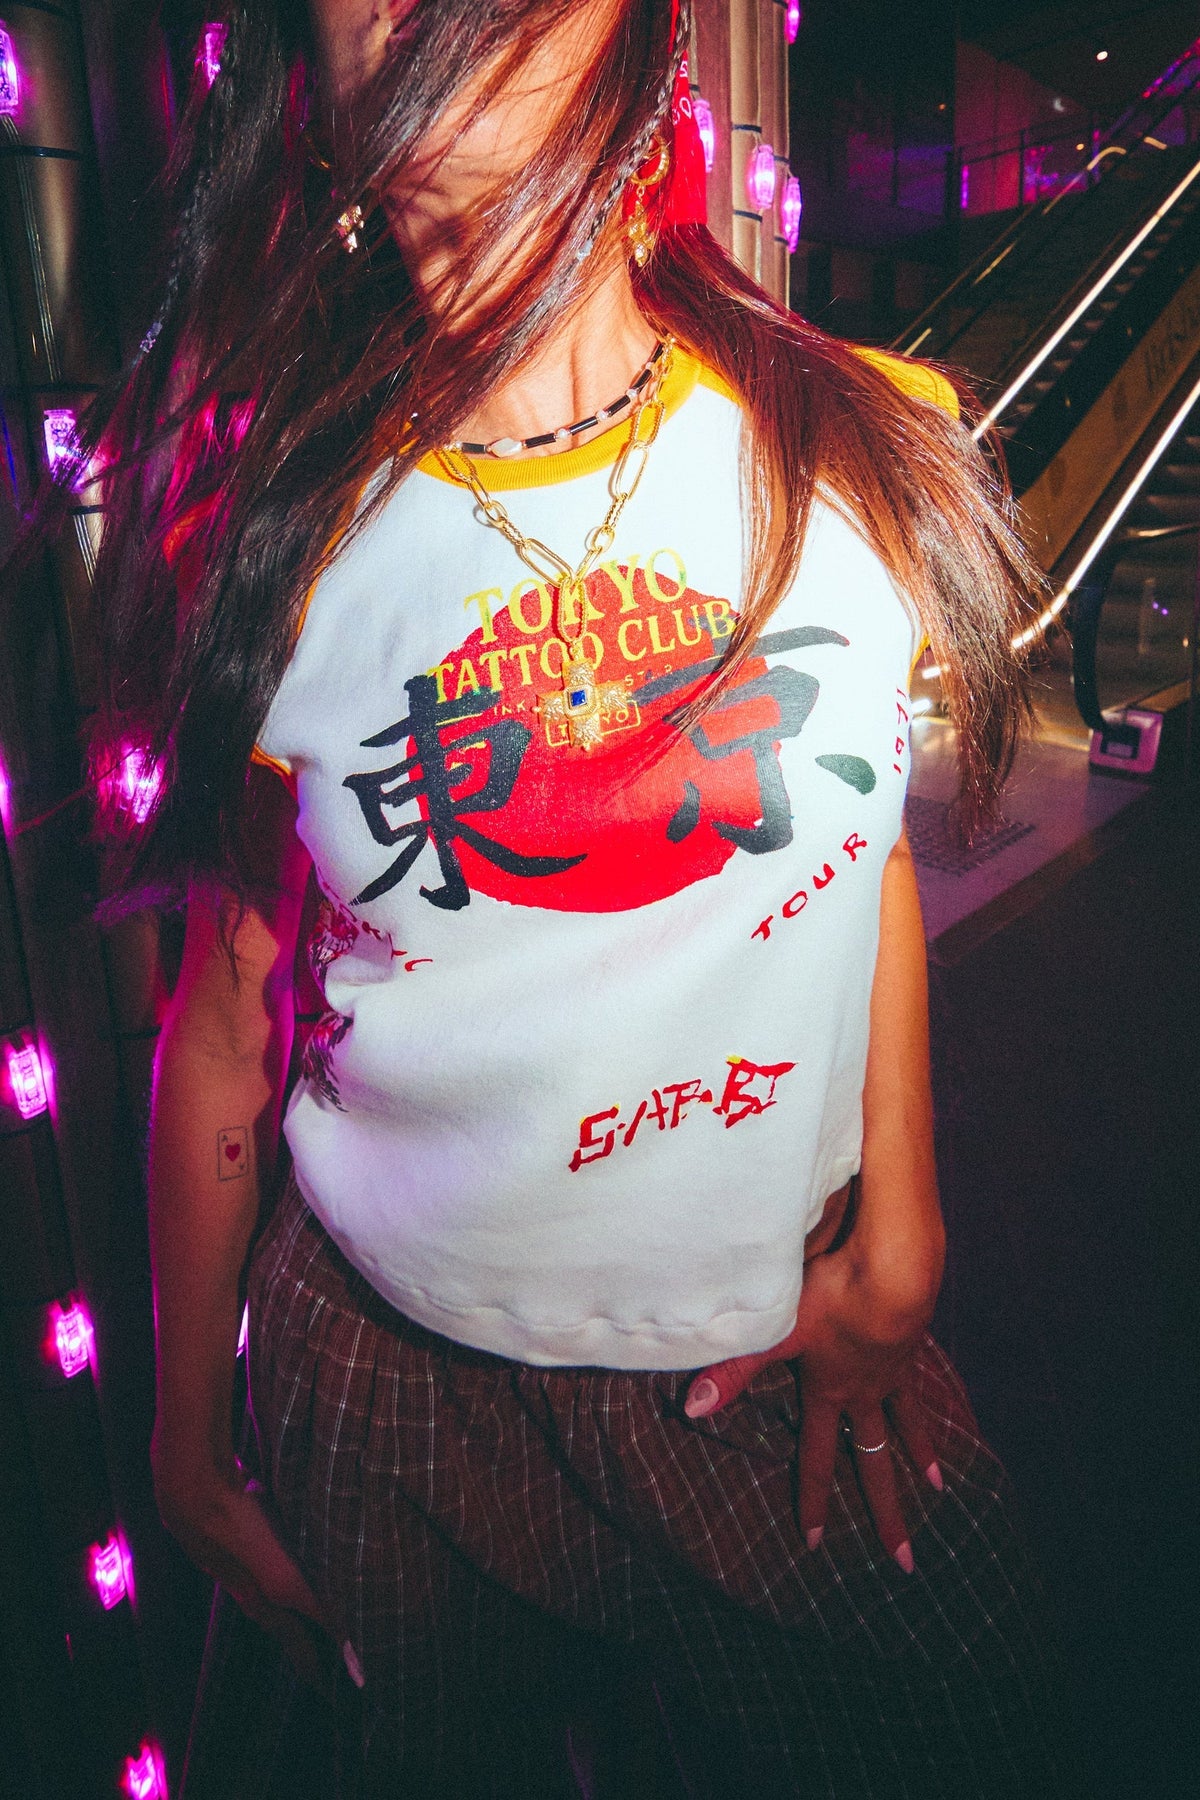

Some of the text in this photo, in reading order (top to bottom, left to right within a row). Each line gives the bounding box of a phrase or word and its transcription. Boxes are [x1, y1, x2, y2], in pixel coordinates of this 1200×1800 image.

[464, 547, 688, 646] TOKYO
[428, 599, 736, 704] TATTOO CLUB
[342, 627, 876, 912] 東京
[750, 832, 868, 941] TOUR
